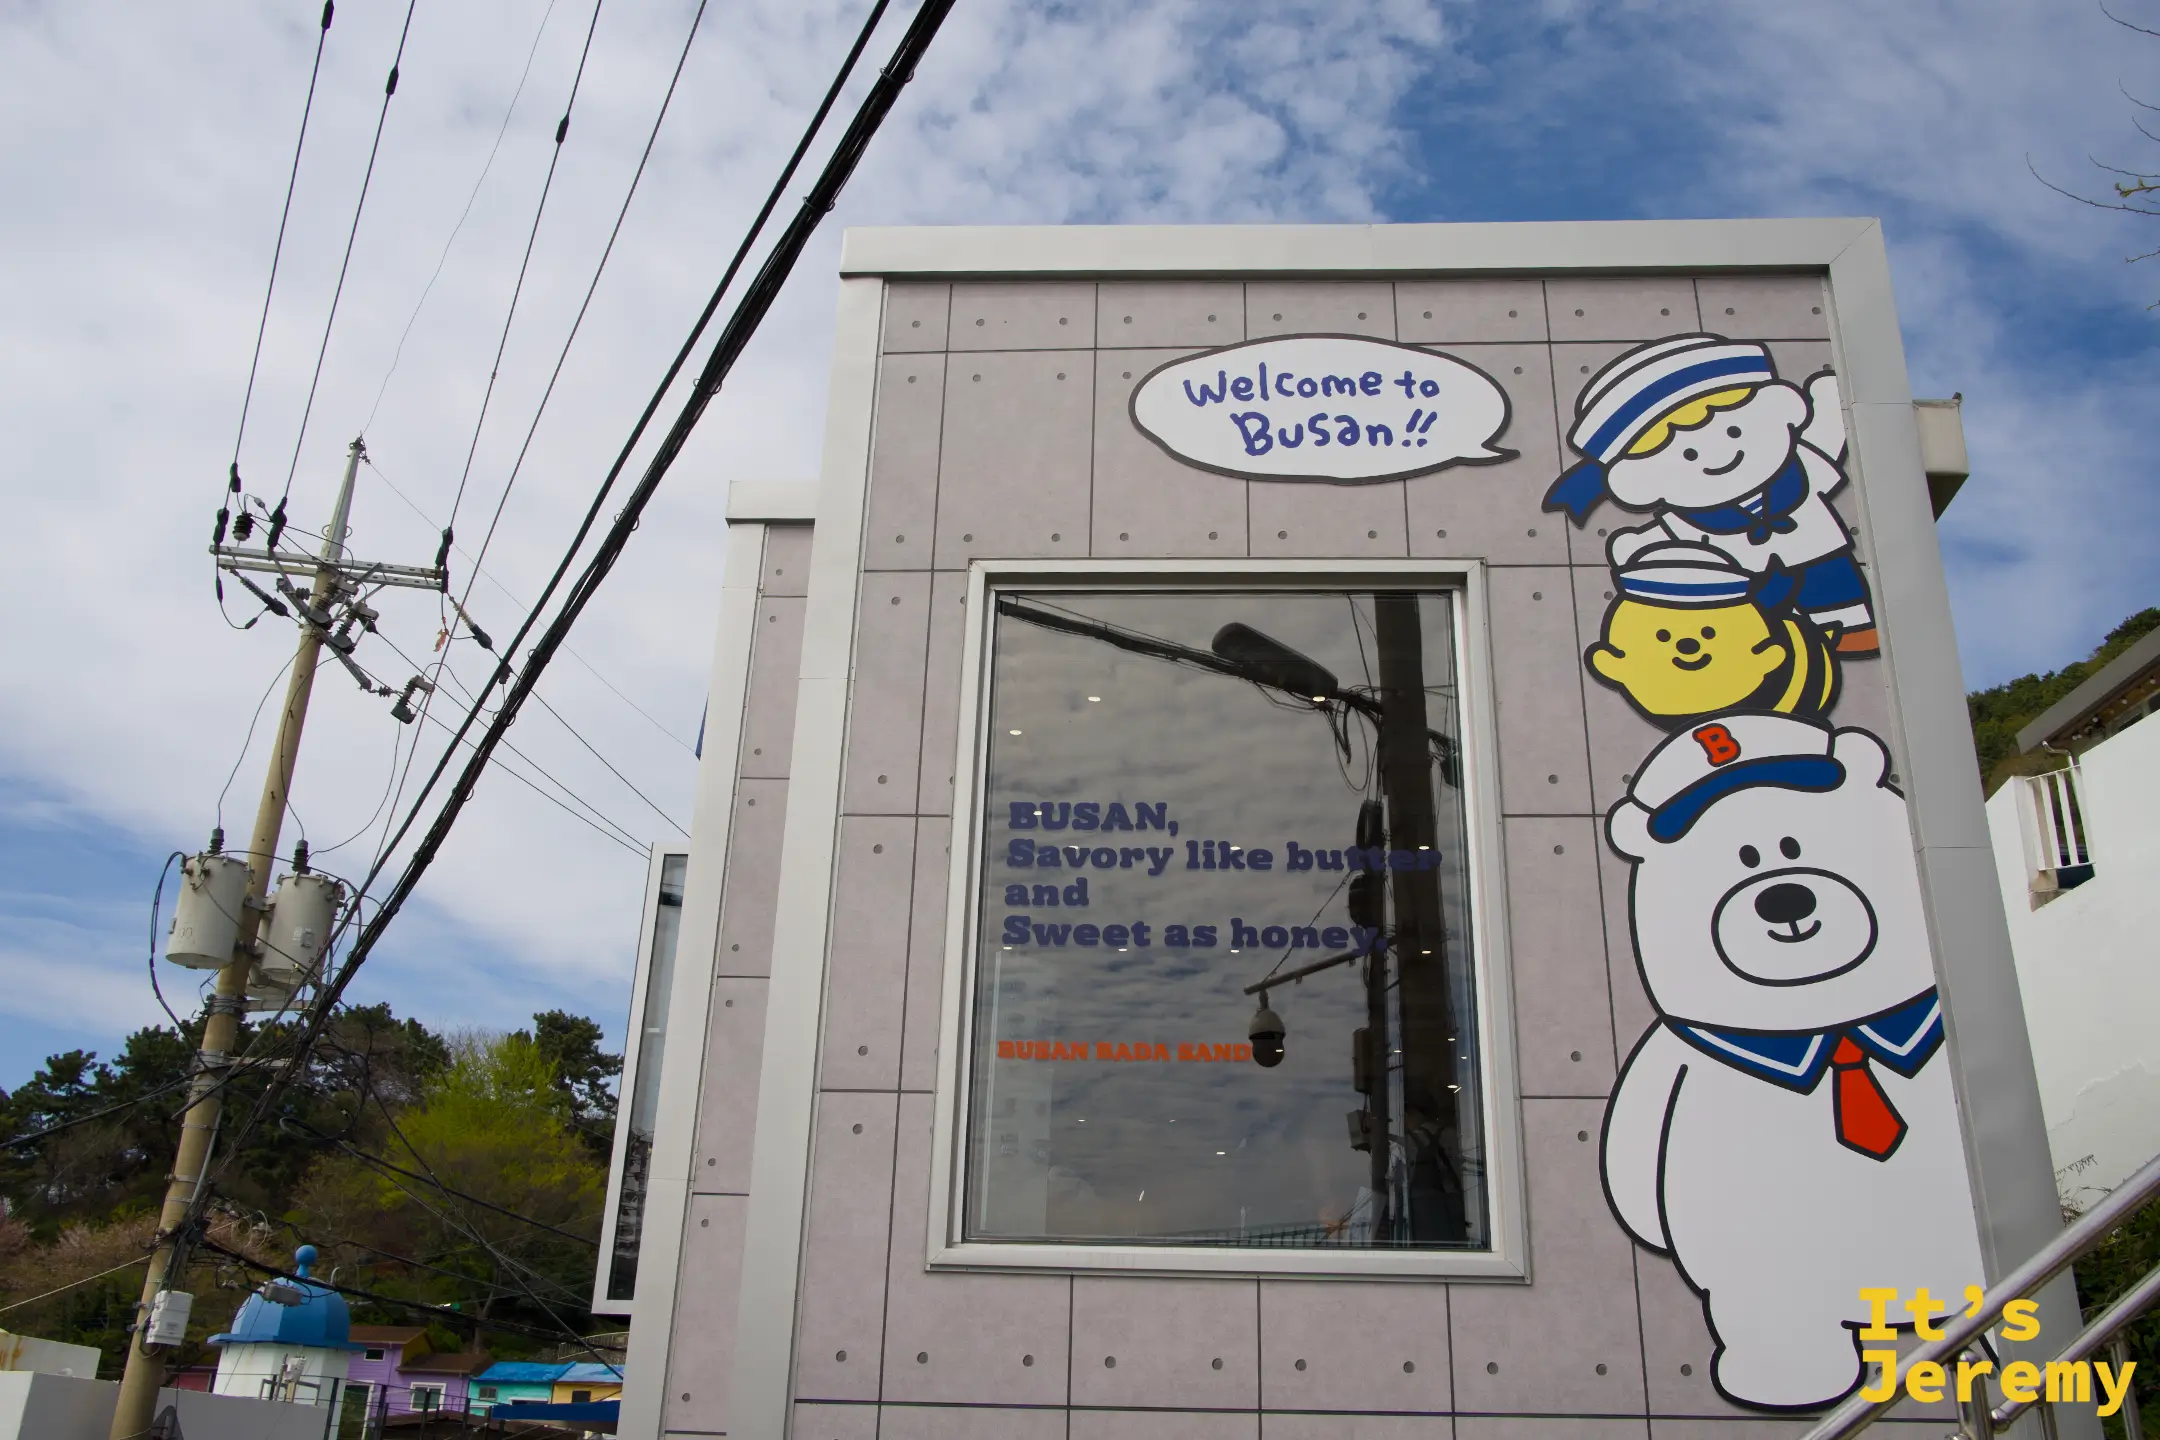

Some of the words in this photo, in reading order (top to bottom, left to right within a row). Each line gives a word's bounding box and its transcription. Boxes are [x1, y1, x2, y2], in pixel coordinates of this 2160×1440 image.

[1183, 362, 1383, 406] Welcome
[1394, 371, 1440, 399] to
[1230, 408, 1438, 456] Busan!!
[1692, 723, 1741, 767] B
[1008, 801, 1179, 836] BUSAN,
[1006, 839, 1174, 876] Savory
[1186, 840, 1274, 871] like
[1286, 841, 1443, 871] butter
[1004, 877, 1090, 906] and
[1002, 915, 1151, 947] Sweet
[1164, 925, 1217, 948] as
[1230, 918, 1388, 956] honey.
[997, 1040, 1089, 1061] BUSAN
[1096, 1041, 1171, 1062] BADA
[1177, 1042, 1254, 1062] SAND
